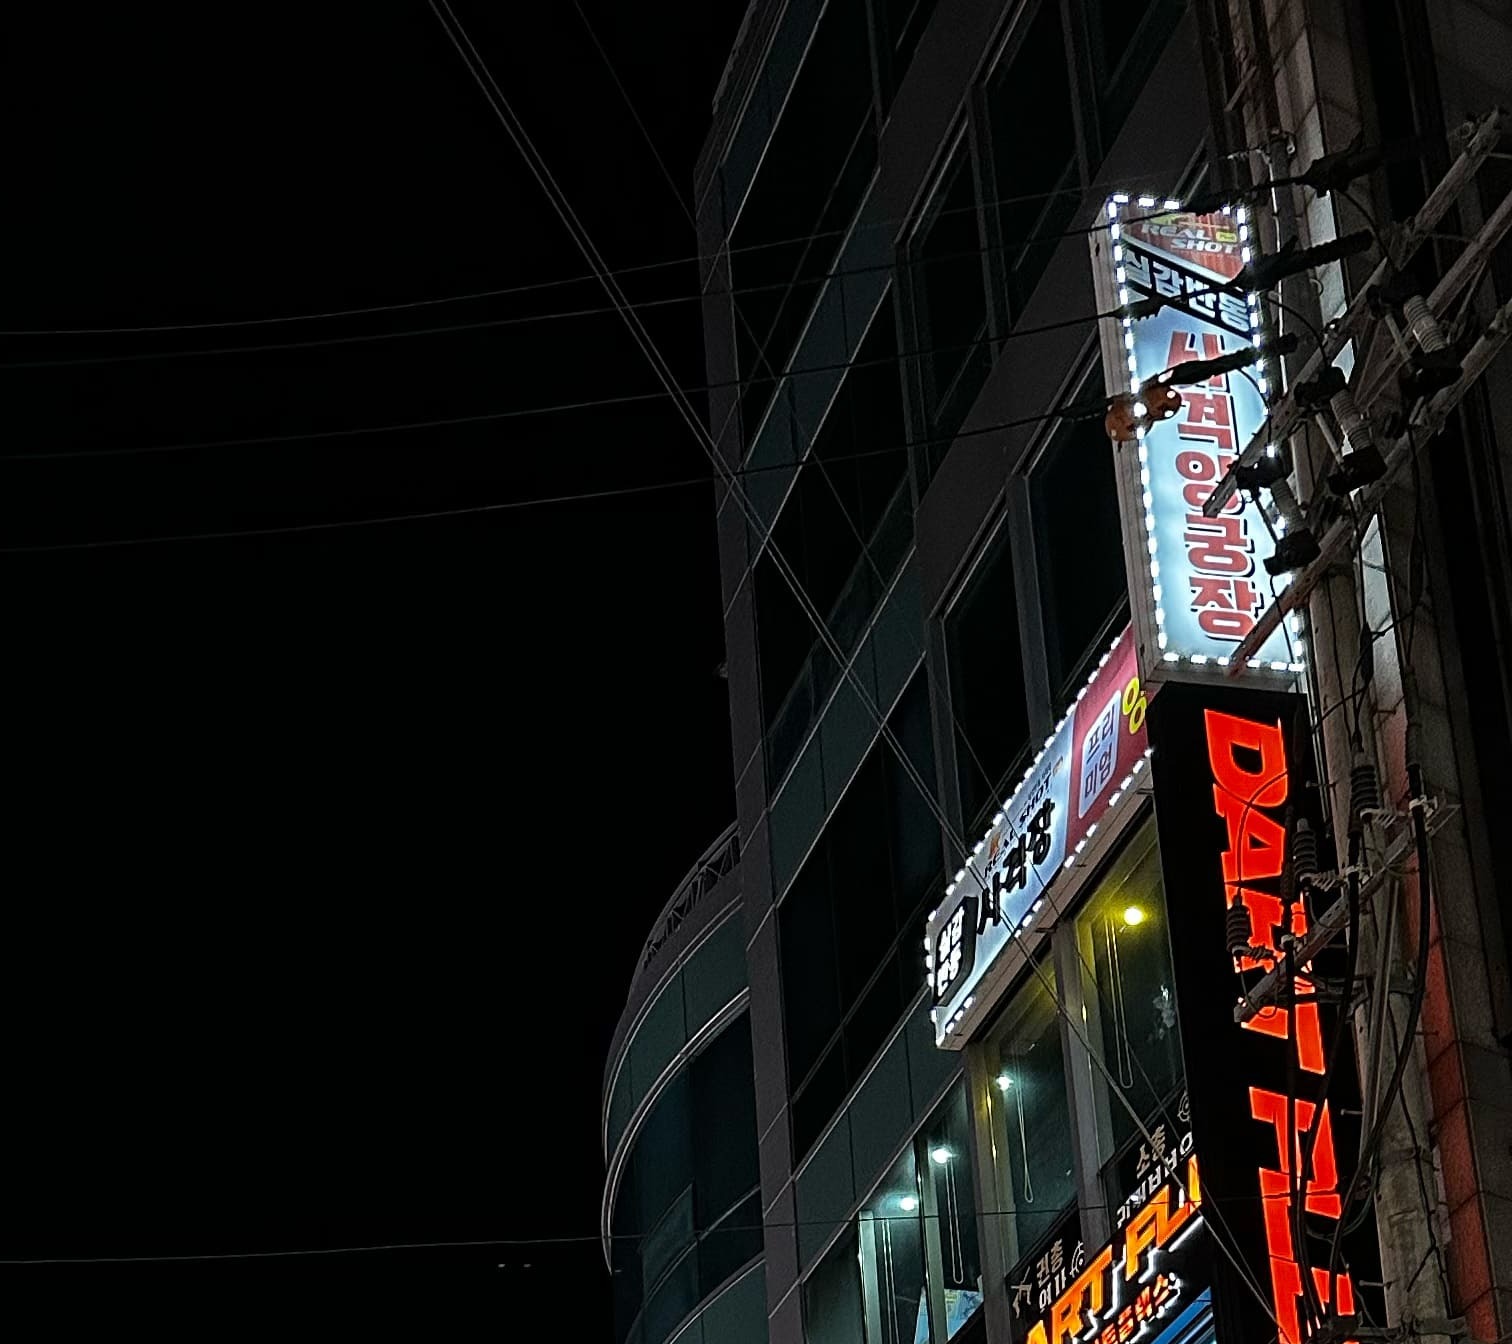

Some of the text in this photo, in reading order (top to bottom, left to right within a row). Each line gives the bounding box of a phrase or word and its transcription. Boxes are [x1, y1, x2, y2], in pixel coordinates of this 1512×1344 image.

[1171, 237, 1237, 254] SHOT
[1126, 250, 1250, 332] 실감반동
[1167, 330, 1259, 638] 사격양궁장
[1088, 704, 1116, 757] 프리
[1084, 746, 1114, 797] 미엄
[976, 799, 1056, 935] 사격장
